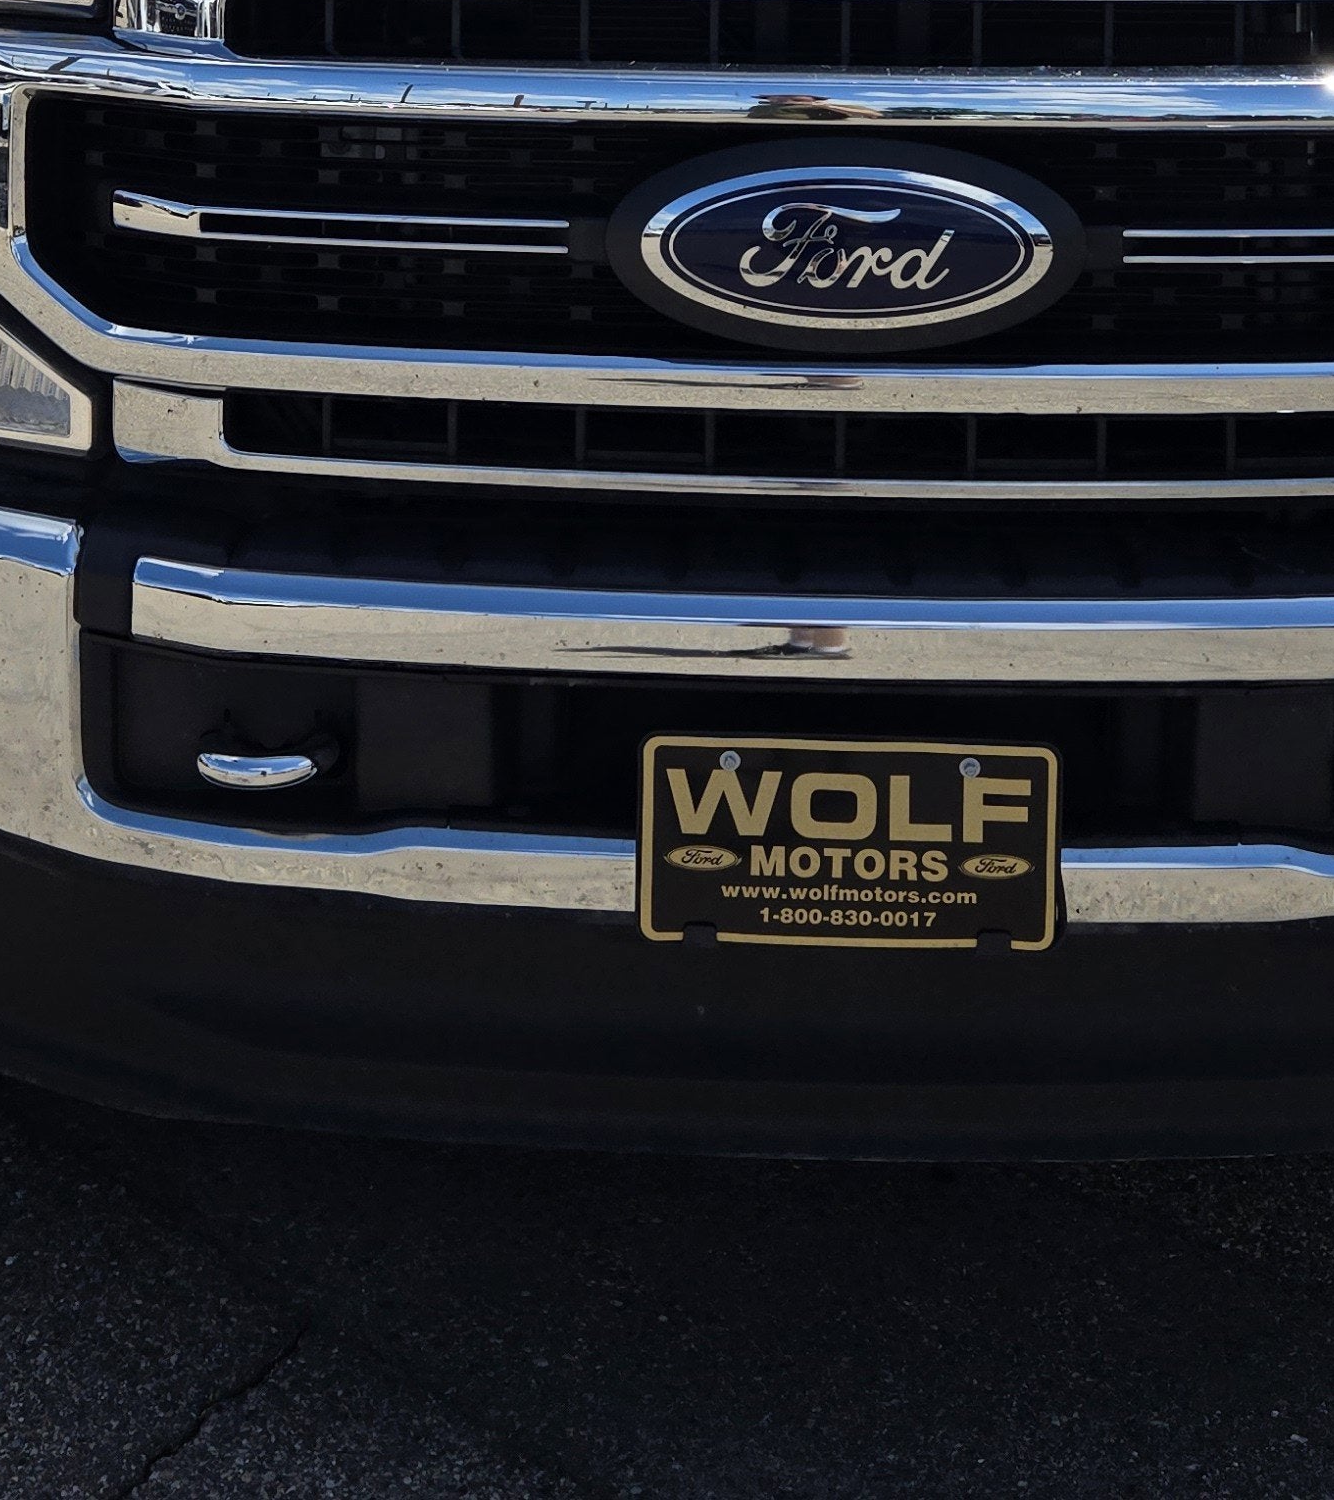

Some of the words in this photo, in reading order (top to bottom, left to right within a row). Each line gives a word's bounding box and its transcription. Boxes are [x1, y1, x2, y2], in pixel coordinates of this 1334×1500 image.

[739, 202, 955, 290] Ford
[666, 767, 1032, 843] WOLF
[678, 847, 724, 867] Ford
[749, 845, 949, 882] MOTORS
[974, 857, 1018, 876] Ford
[721, 882, 977, 905] www.wolfmotors.com
[759, 906, 938, 928] 1-800-830-0017
